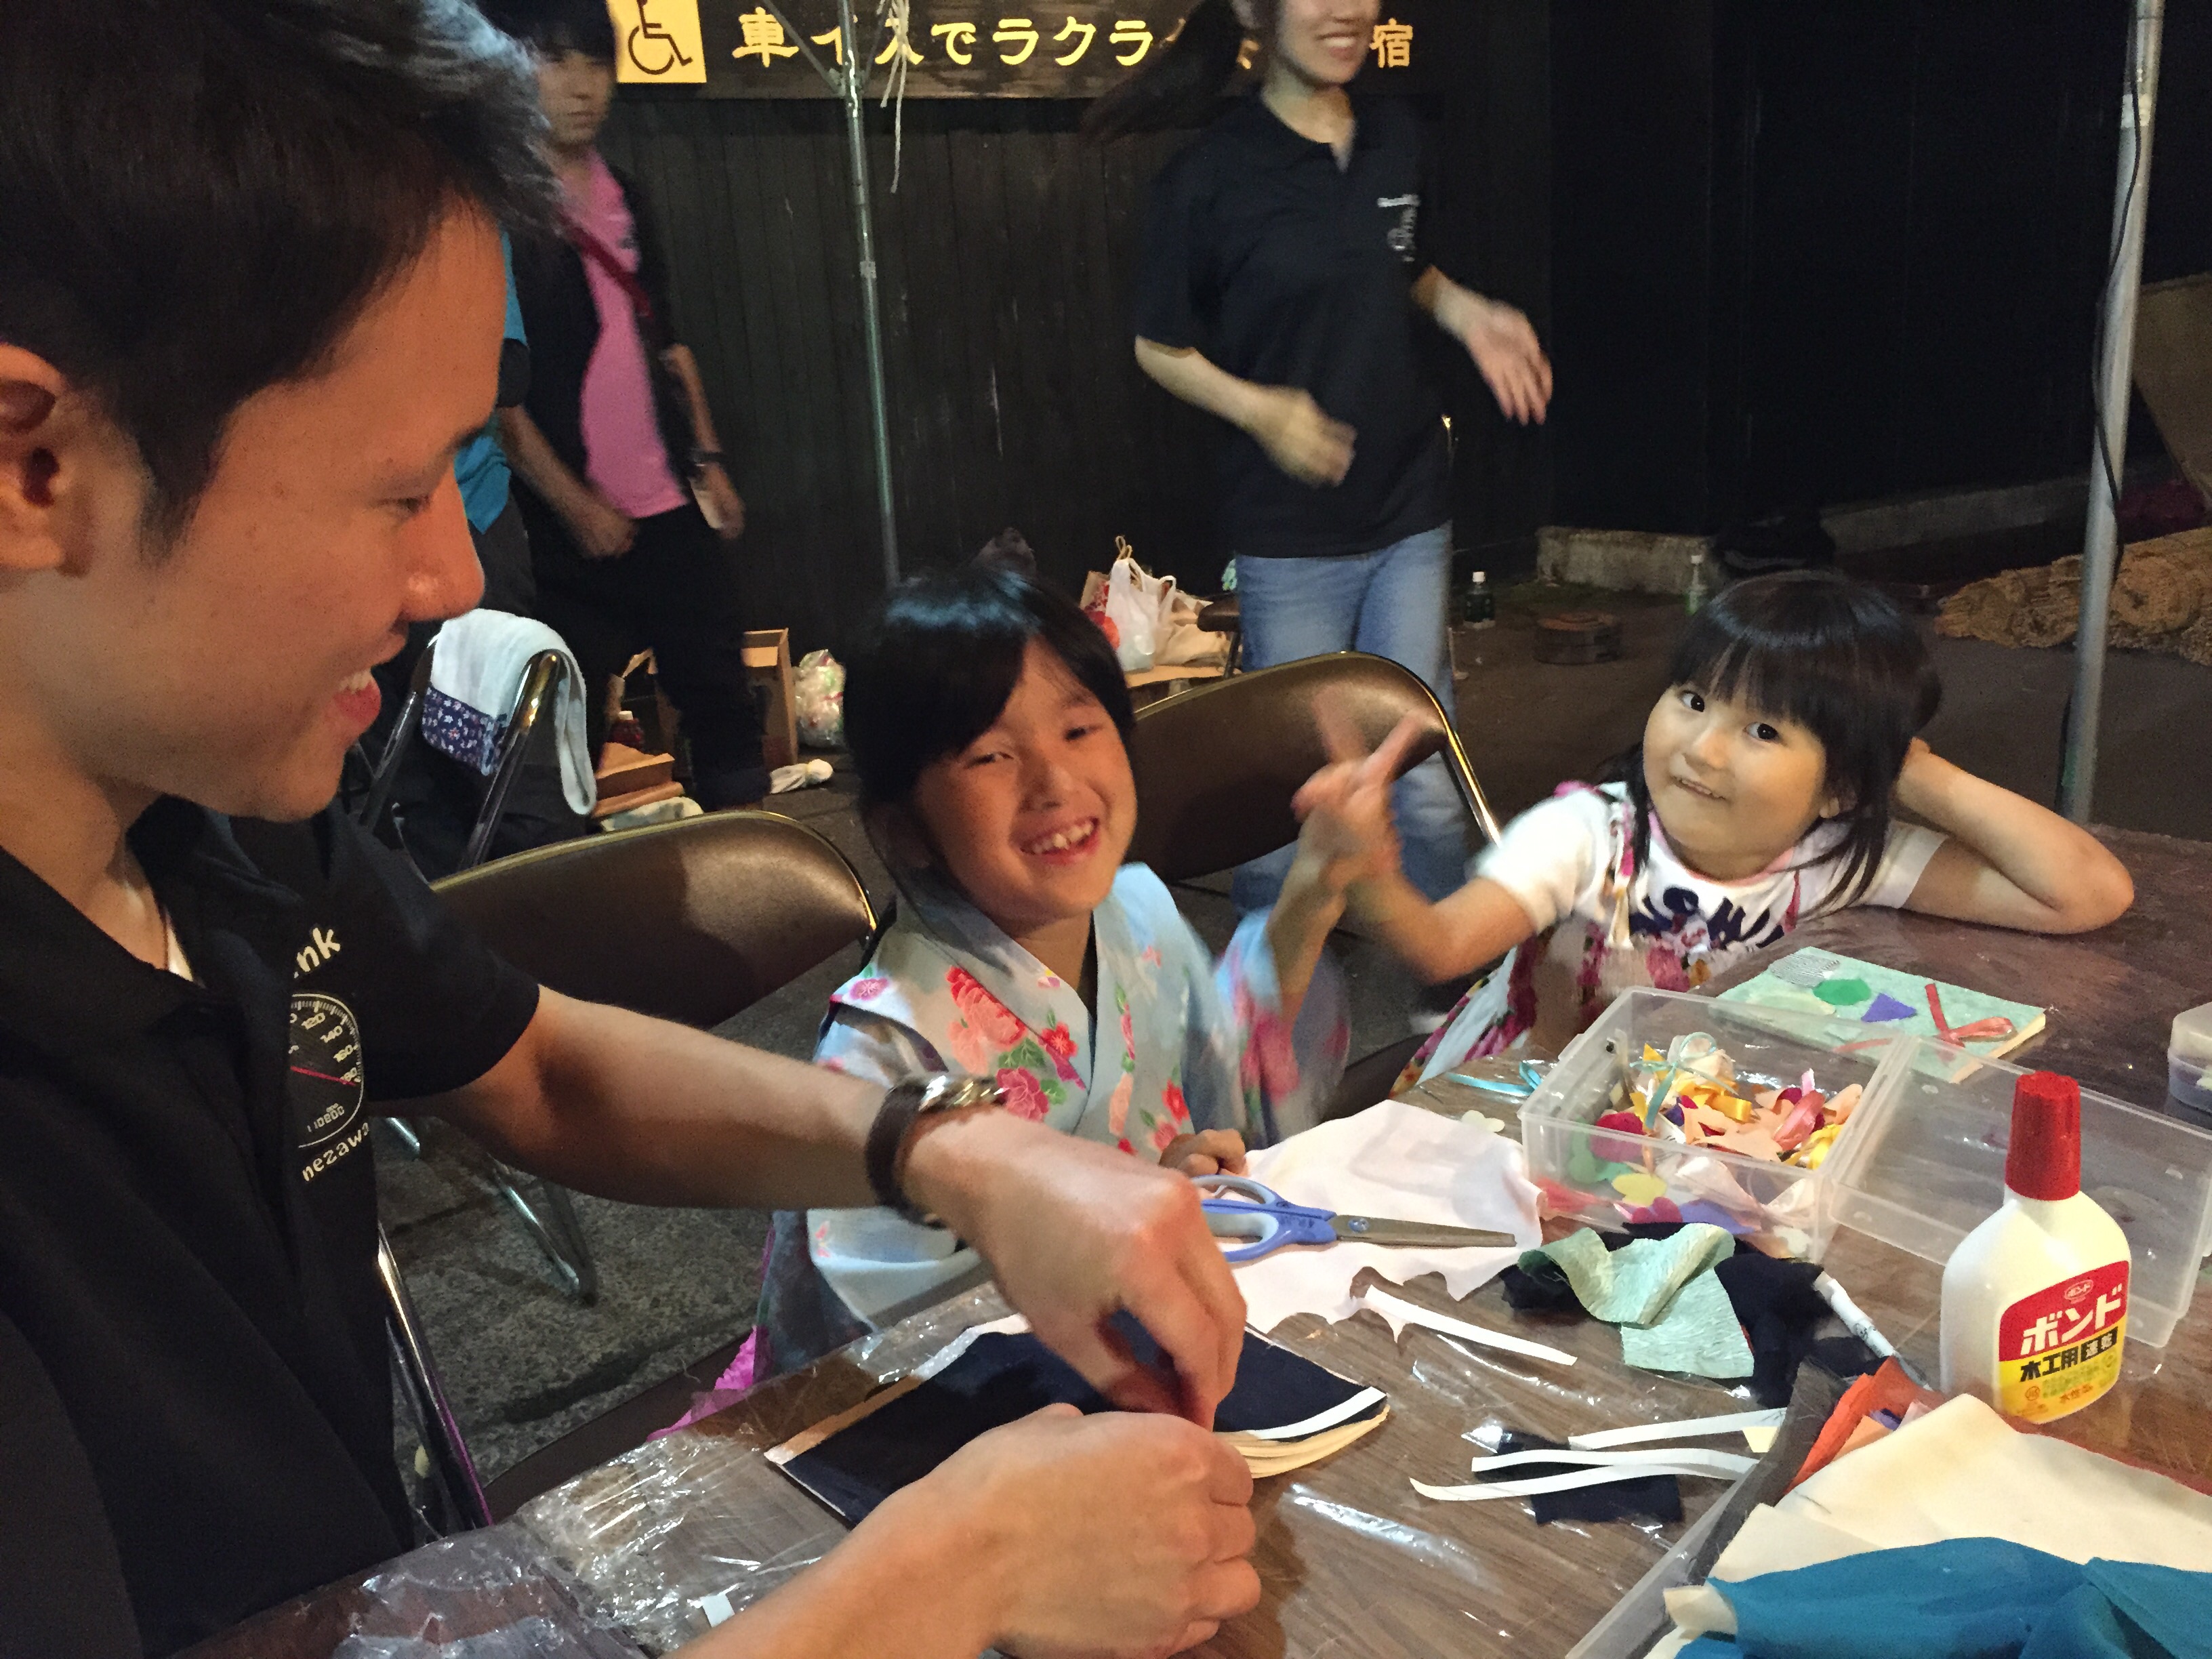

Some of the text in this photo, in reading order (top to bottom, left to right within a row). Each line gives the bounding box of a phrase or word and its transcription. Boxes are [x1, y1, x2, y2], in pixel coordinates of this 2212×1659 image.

[293, 927, 340, 979] nk
[2020, 1283, 2123, 1355] ボンド
